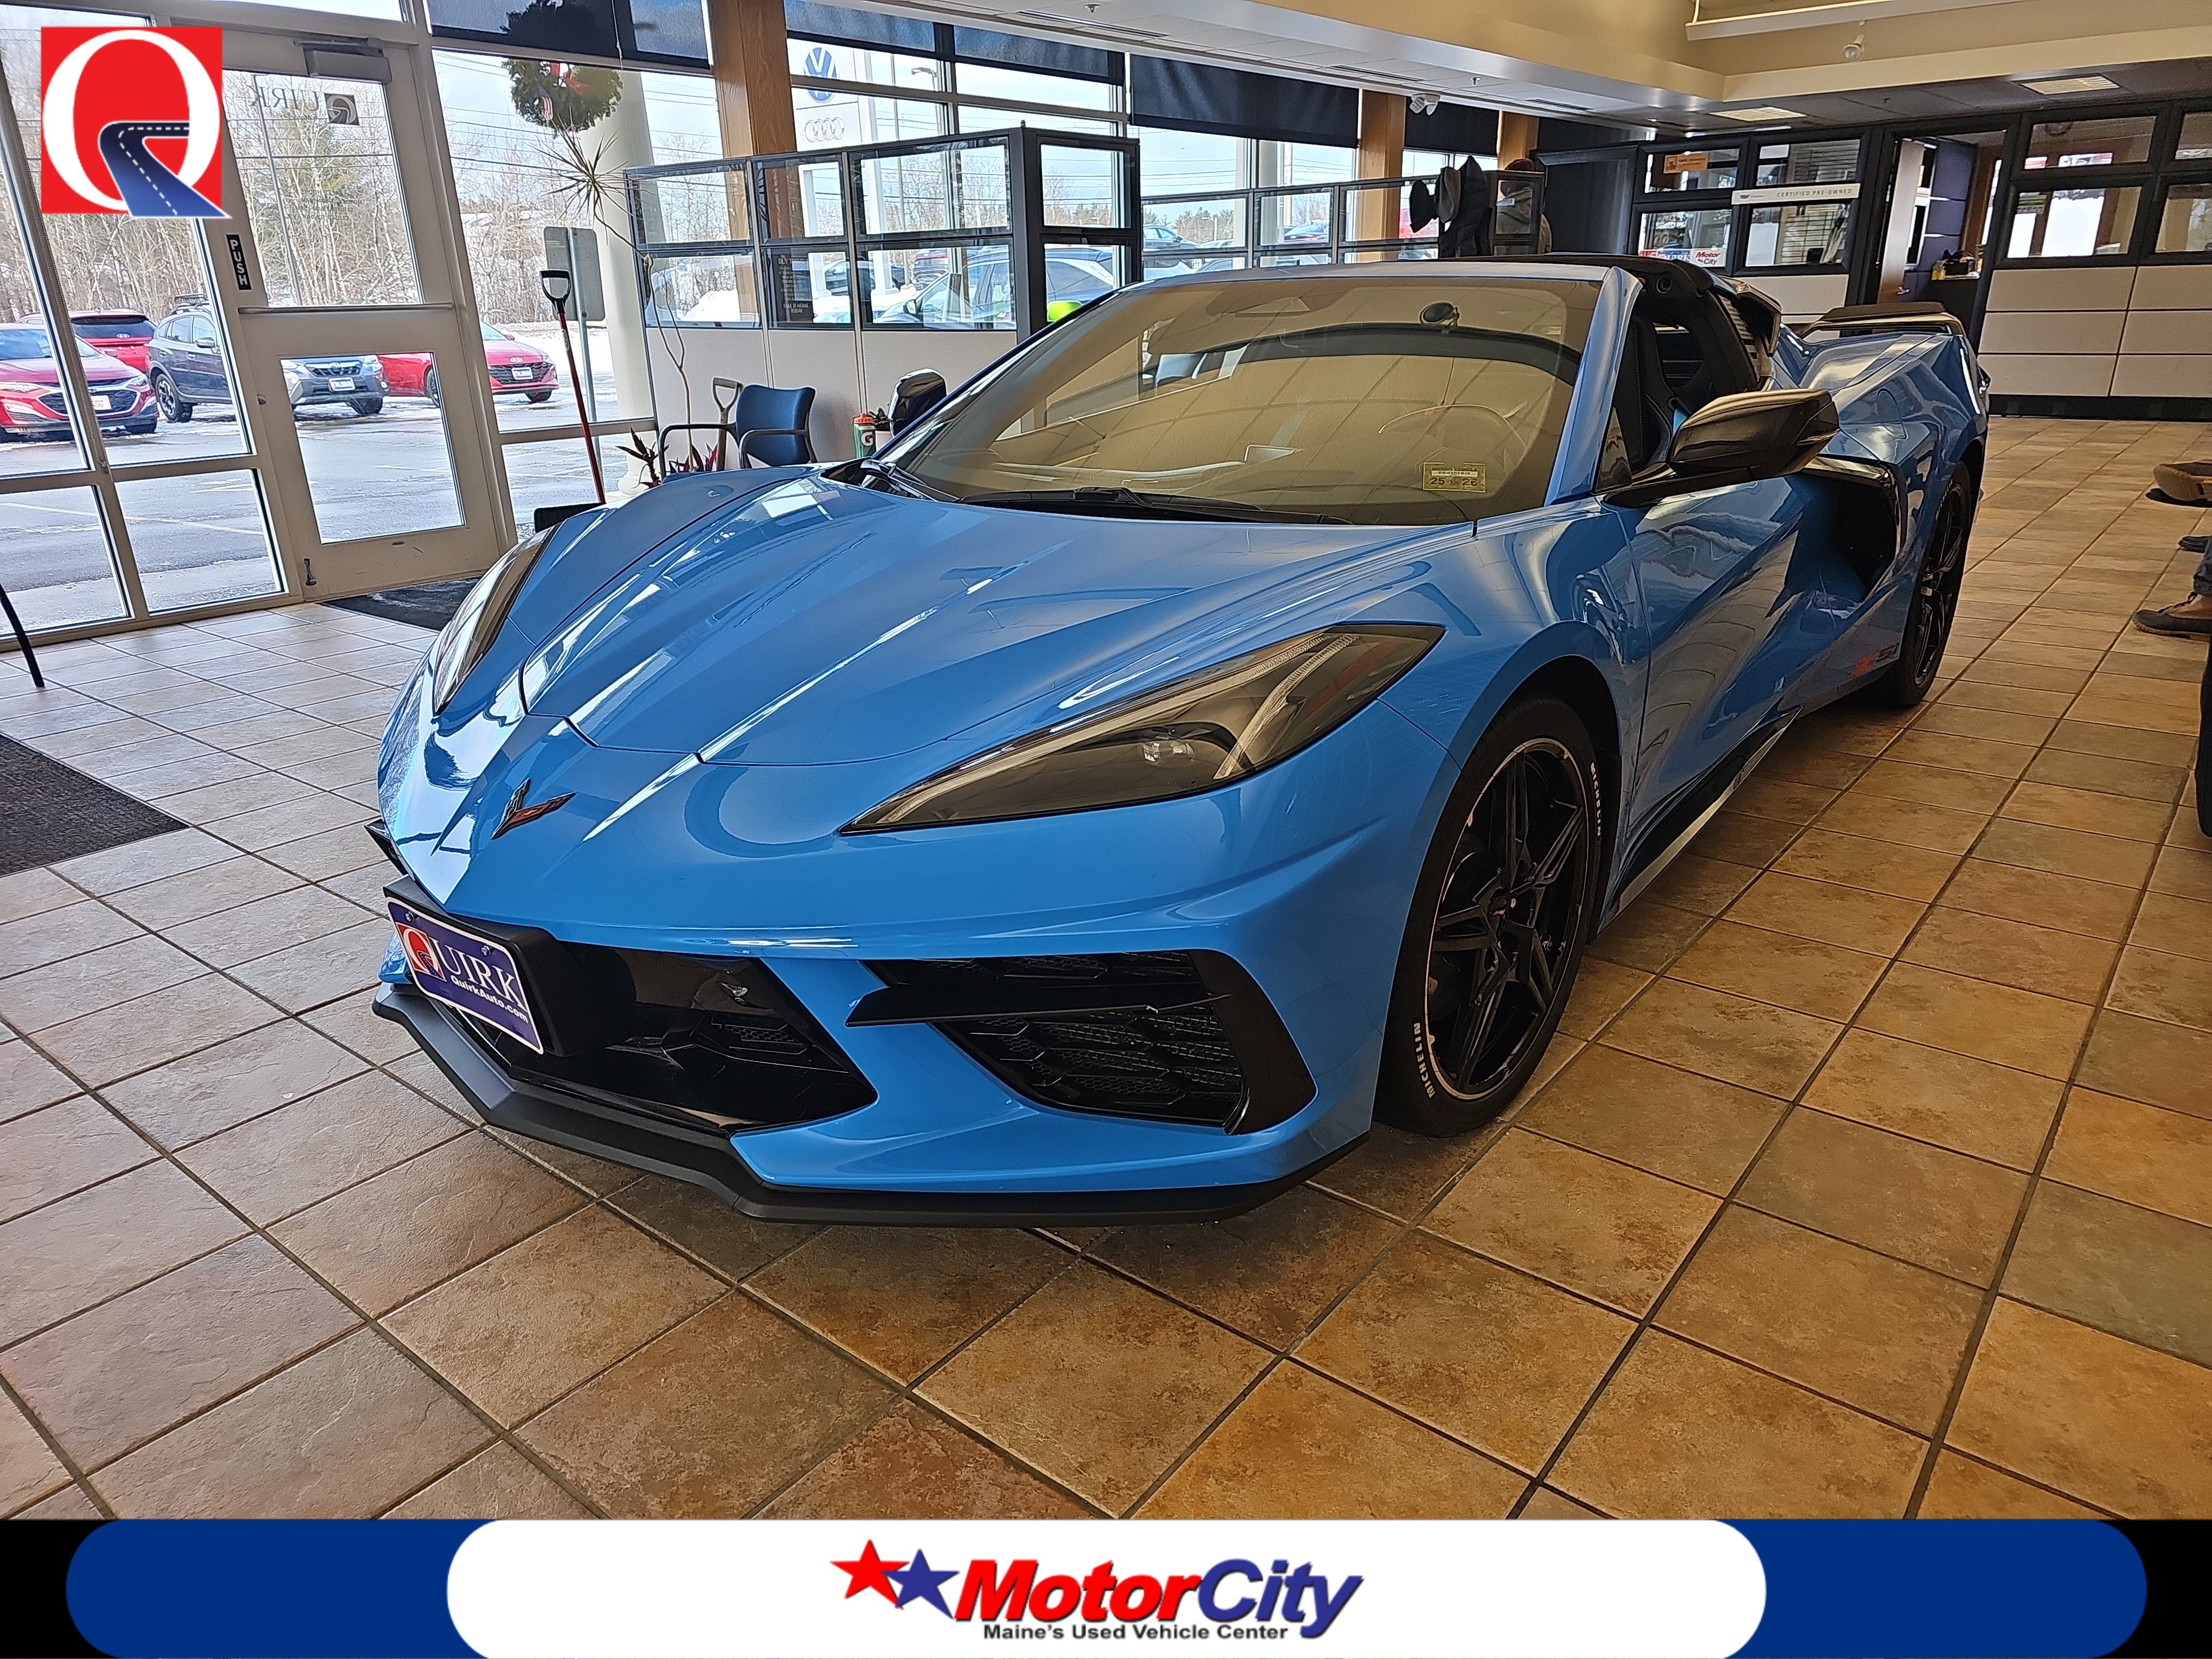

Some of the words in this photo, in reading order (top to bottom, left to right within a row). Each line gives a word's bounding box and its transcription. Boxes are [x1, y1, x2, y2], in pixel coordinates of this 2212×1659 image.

[230, 240, 248, 285] PUSH
[1430, 477, 1445, 485] 25
[1462, 478, 1478, 486] 26
[1590, 762, 1602, 837] MICHELIN
[403, 928, 529, 1013] QUIRK
[450, 974, 529, 1024] QuirkAuto.com
[1413, 1022, 1436, 1098] MICHELIN
